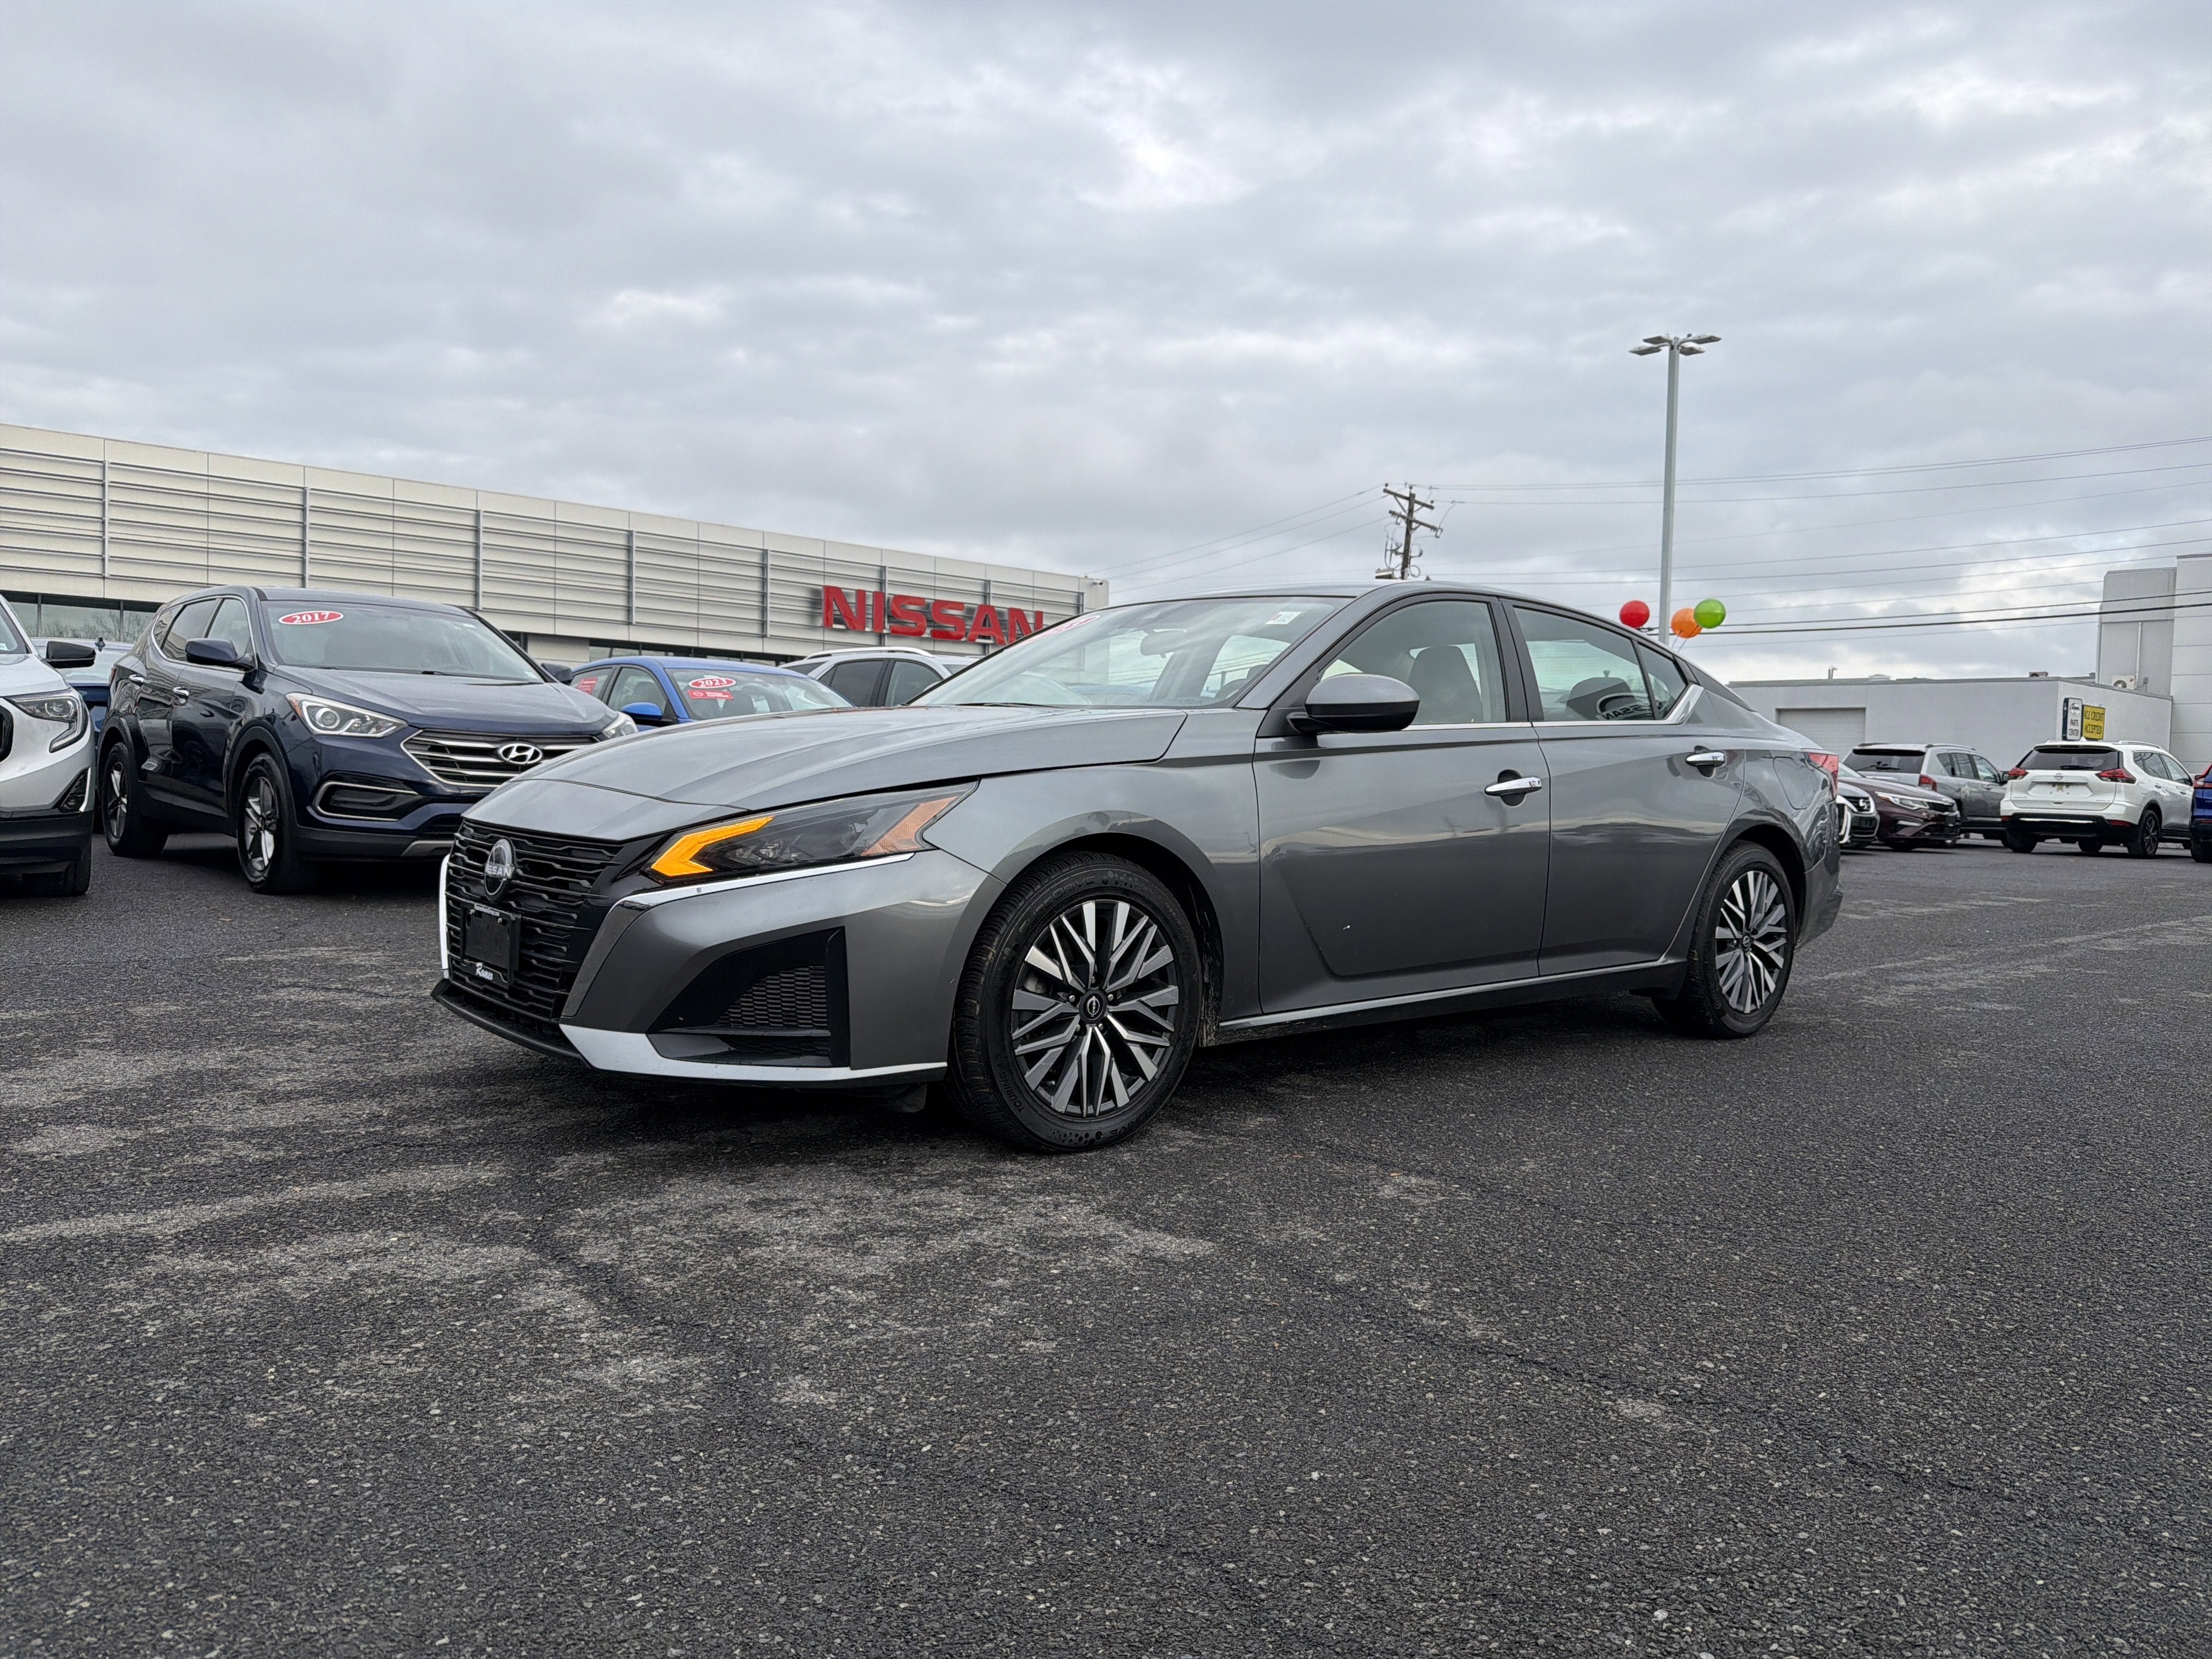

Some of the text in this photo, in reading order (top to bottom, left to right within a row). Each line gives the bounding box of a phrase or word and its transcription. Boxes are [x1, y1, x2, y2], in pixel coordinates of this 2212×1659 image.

[292, 612, 330, 623] 2017
[823, 585, 1043, 645] NISSAN
[698, 678, 727, 687] 2023
[2091, 710, 2104, 723] CREDIT
[2084, 724, 2102, 735] ACCEPTED
